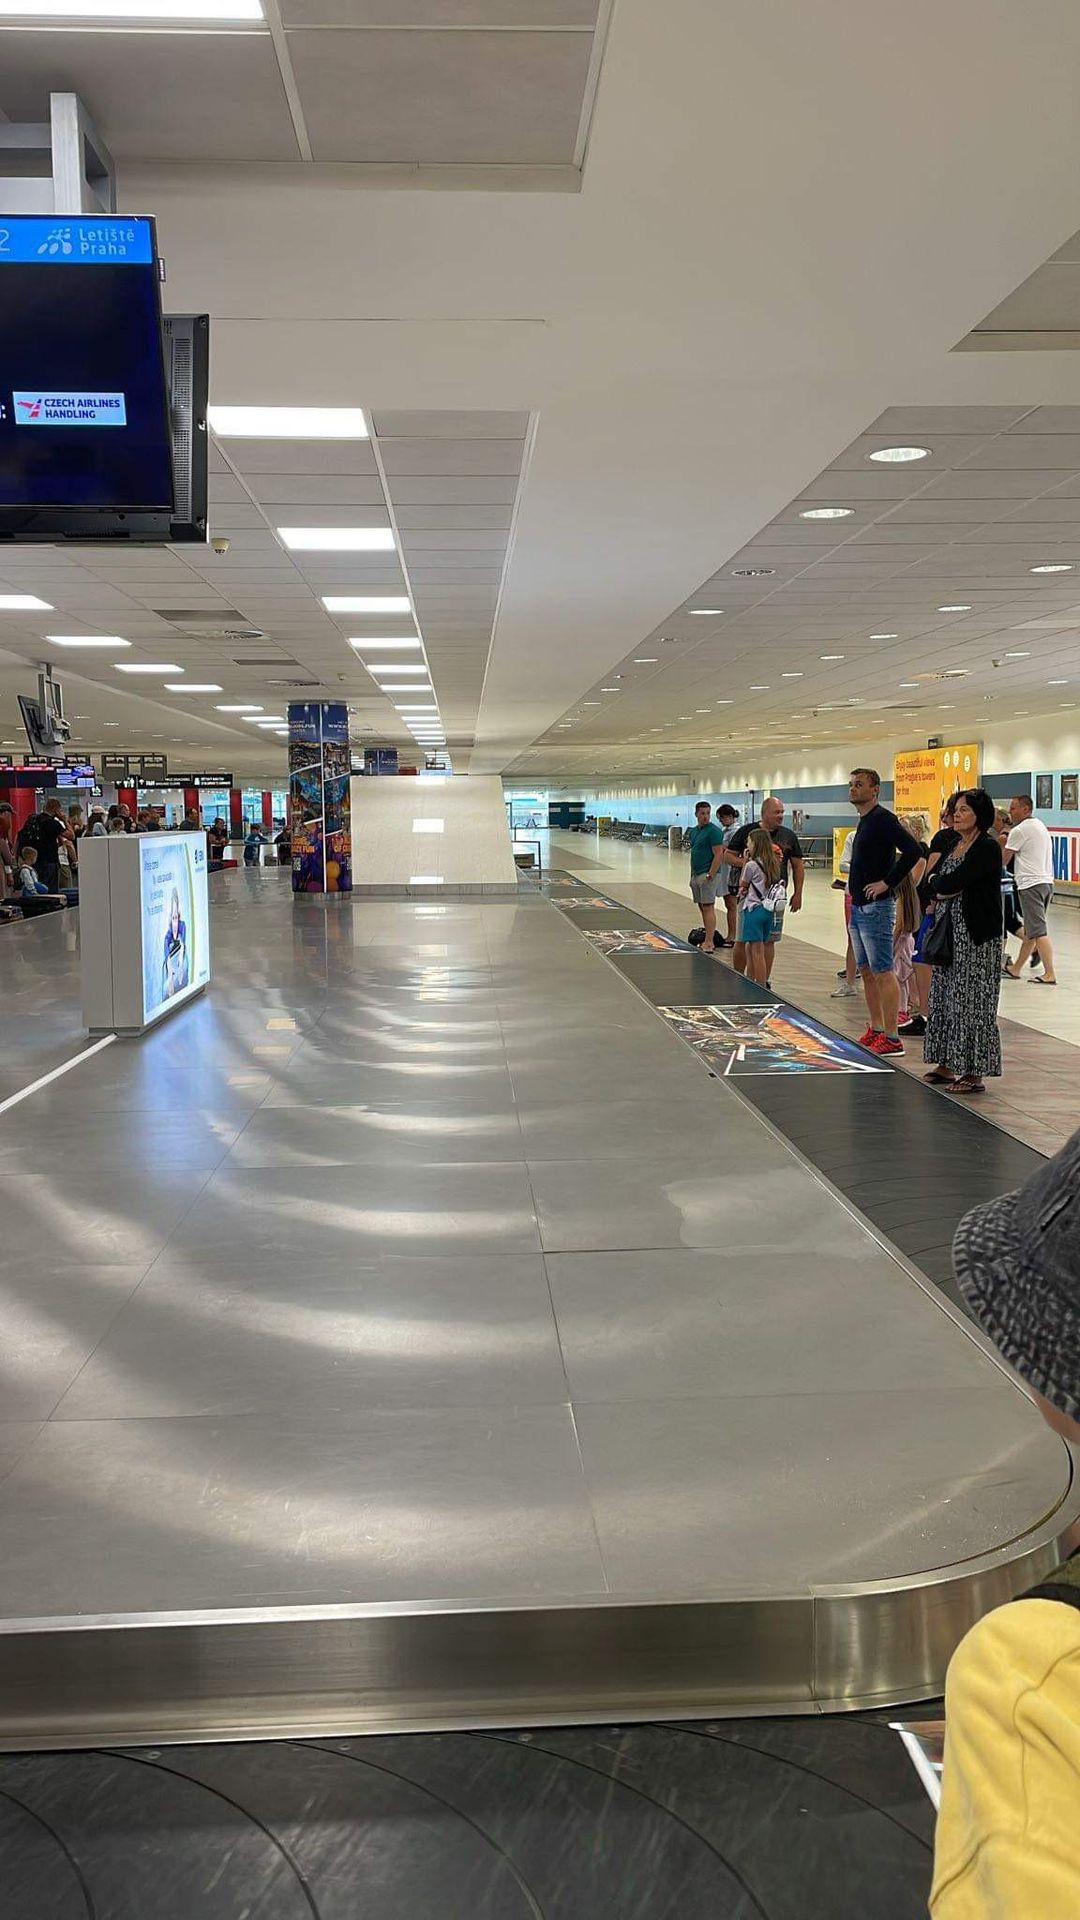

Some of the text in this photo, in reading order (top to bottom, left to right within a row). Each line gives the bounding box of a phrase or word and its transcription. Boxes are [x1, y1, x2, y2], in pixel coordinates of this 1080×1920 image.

[0, 229, 10, 252] 2
[79, 227, 135, 242] Letiště
[80, 241, 127, 255] Praha
[44, 399, 121, 408] CZECH AIRLINES
[45, 410, 96, 419] HANDLING
